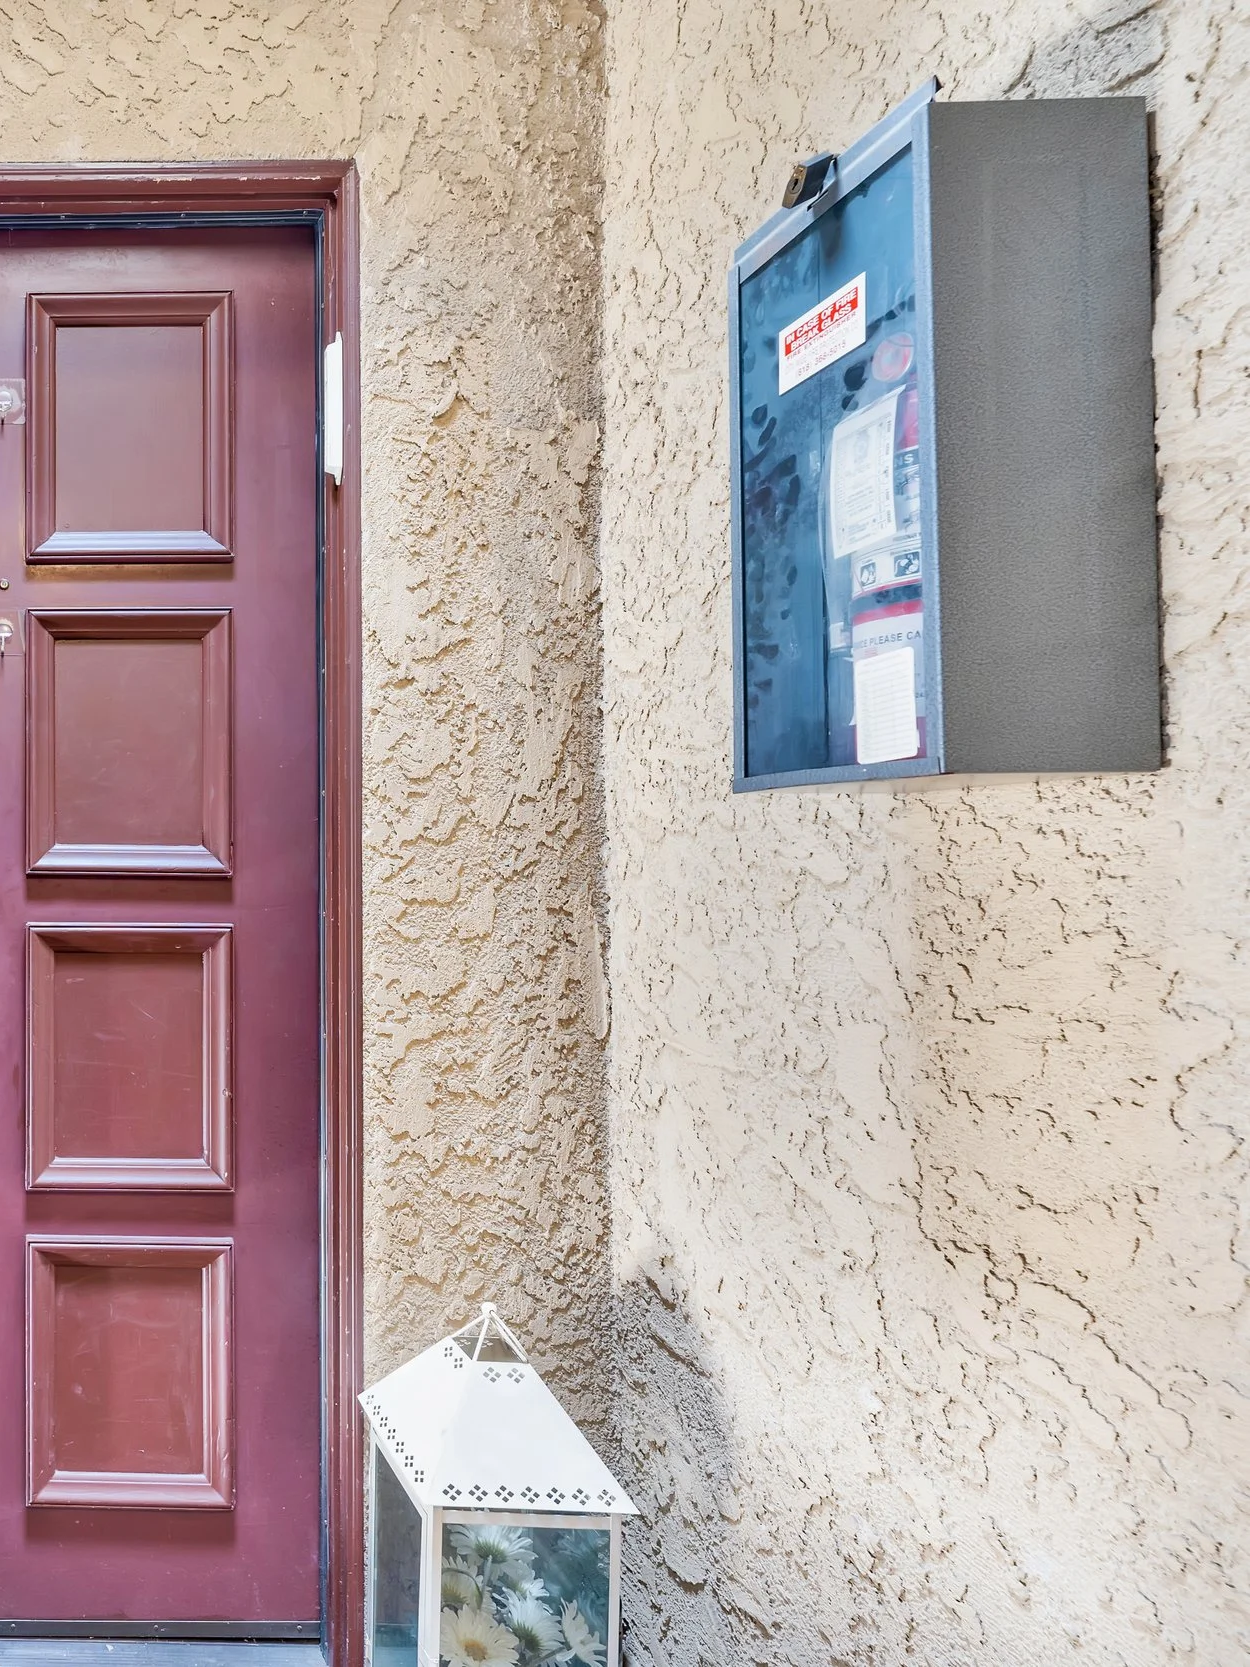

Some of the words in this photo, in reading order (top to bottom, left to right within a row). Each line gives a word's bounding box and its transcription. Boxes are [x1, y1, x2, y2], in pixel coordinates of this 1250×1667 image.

[786, 332, 795, 345] IN
[796, 315, 819, 337] CASE
[820, 305, 834, 320] OF
[835, 288, 857, 310] FIRE
[786, 348, 801, 360] FIRE
[804, 311, 856, 350] EXTINGUISHER
[791, 325, 820, 351] BREAK
[821, 302, 852, 331] GLASS
[869, 633, 903, 646] PLEASE
